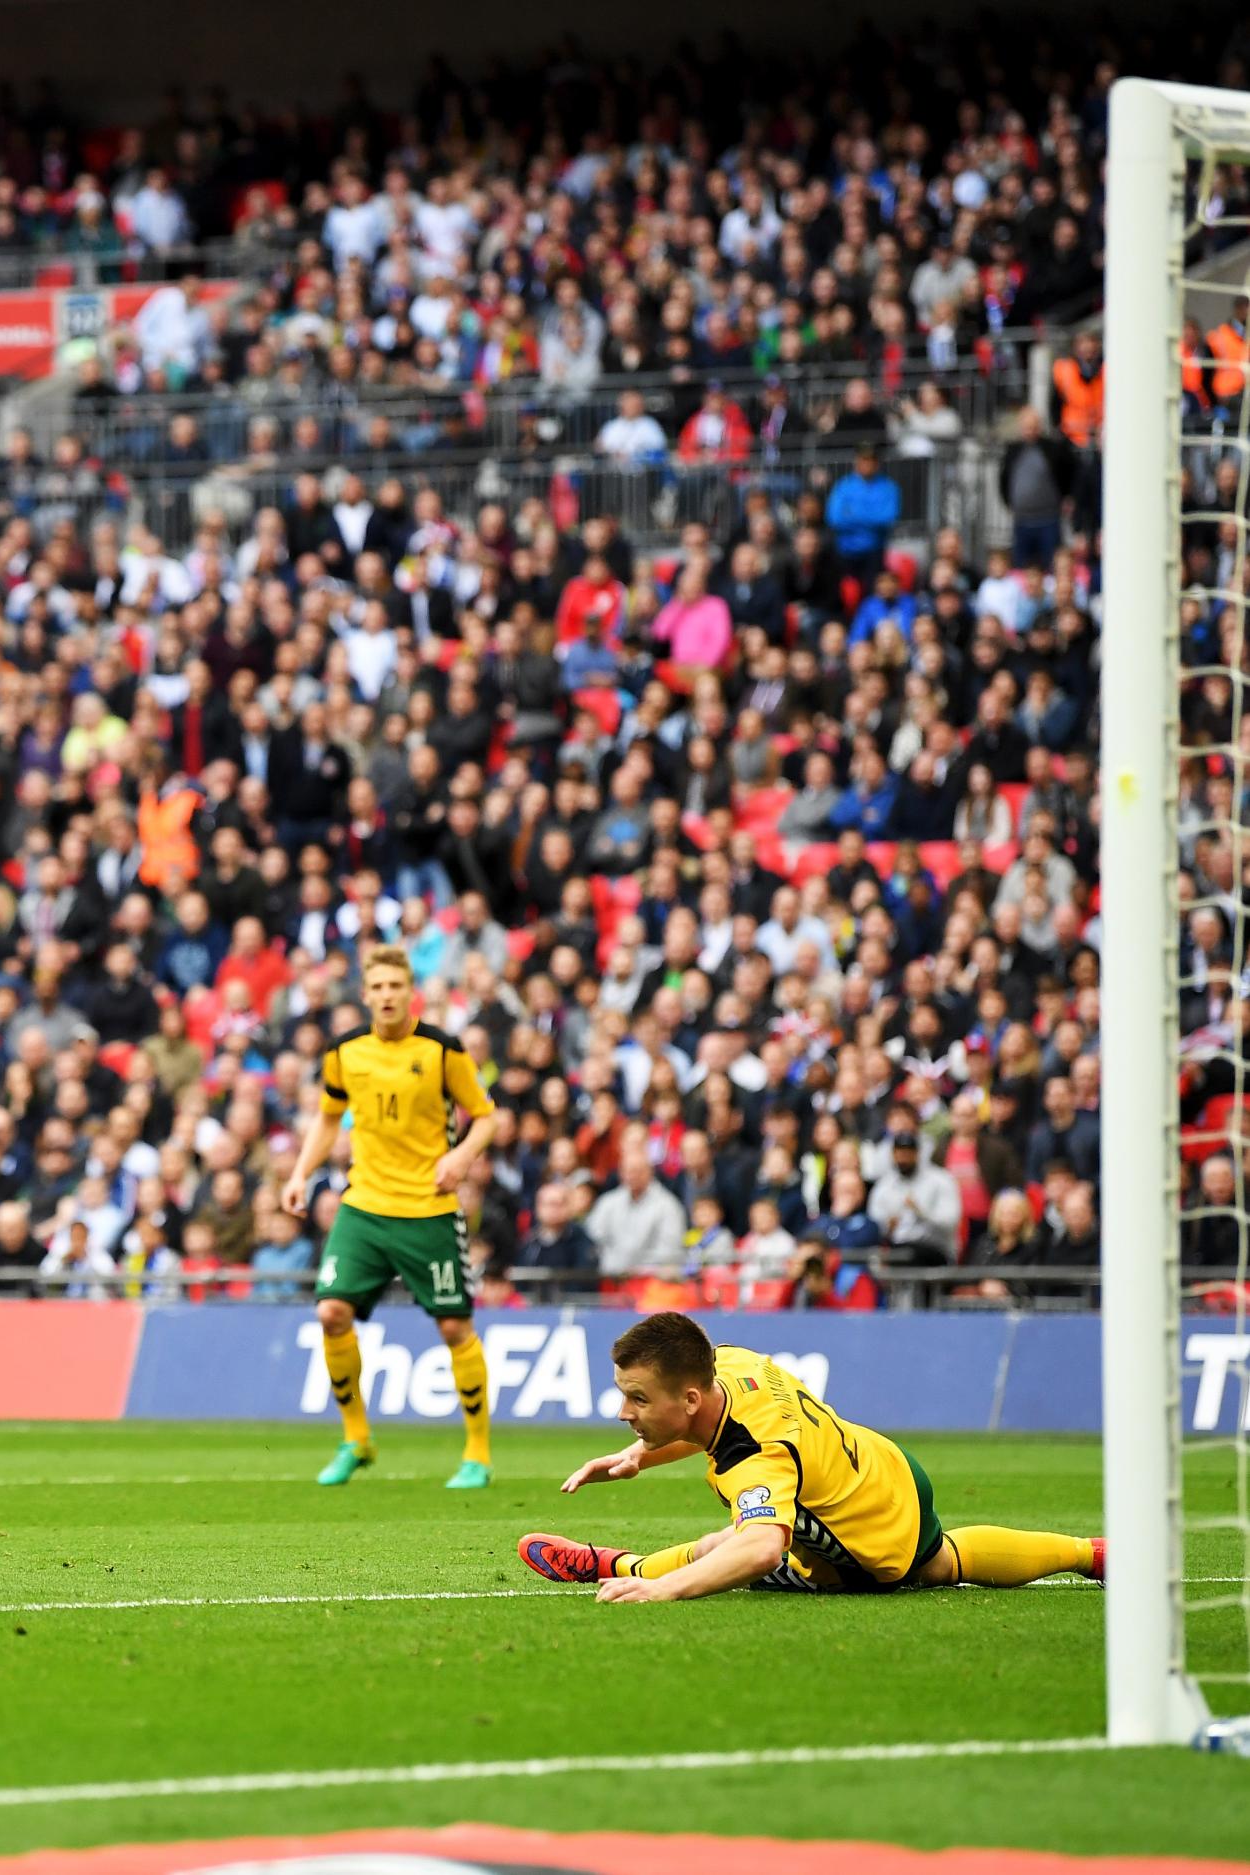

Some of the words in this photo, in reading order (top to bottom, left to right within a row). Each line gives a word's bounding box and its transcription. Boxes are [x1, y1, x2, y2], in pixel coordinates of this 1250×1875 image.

[376, 1092, 399, 1122] 14
[429, 1260, 456, 1295] 14
[796, 1390, 859, 1475] 2
[742, 1508, 775, 1518] RESPECT
